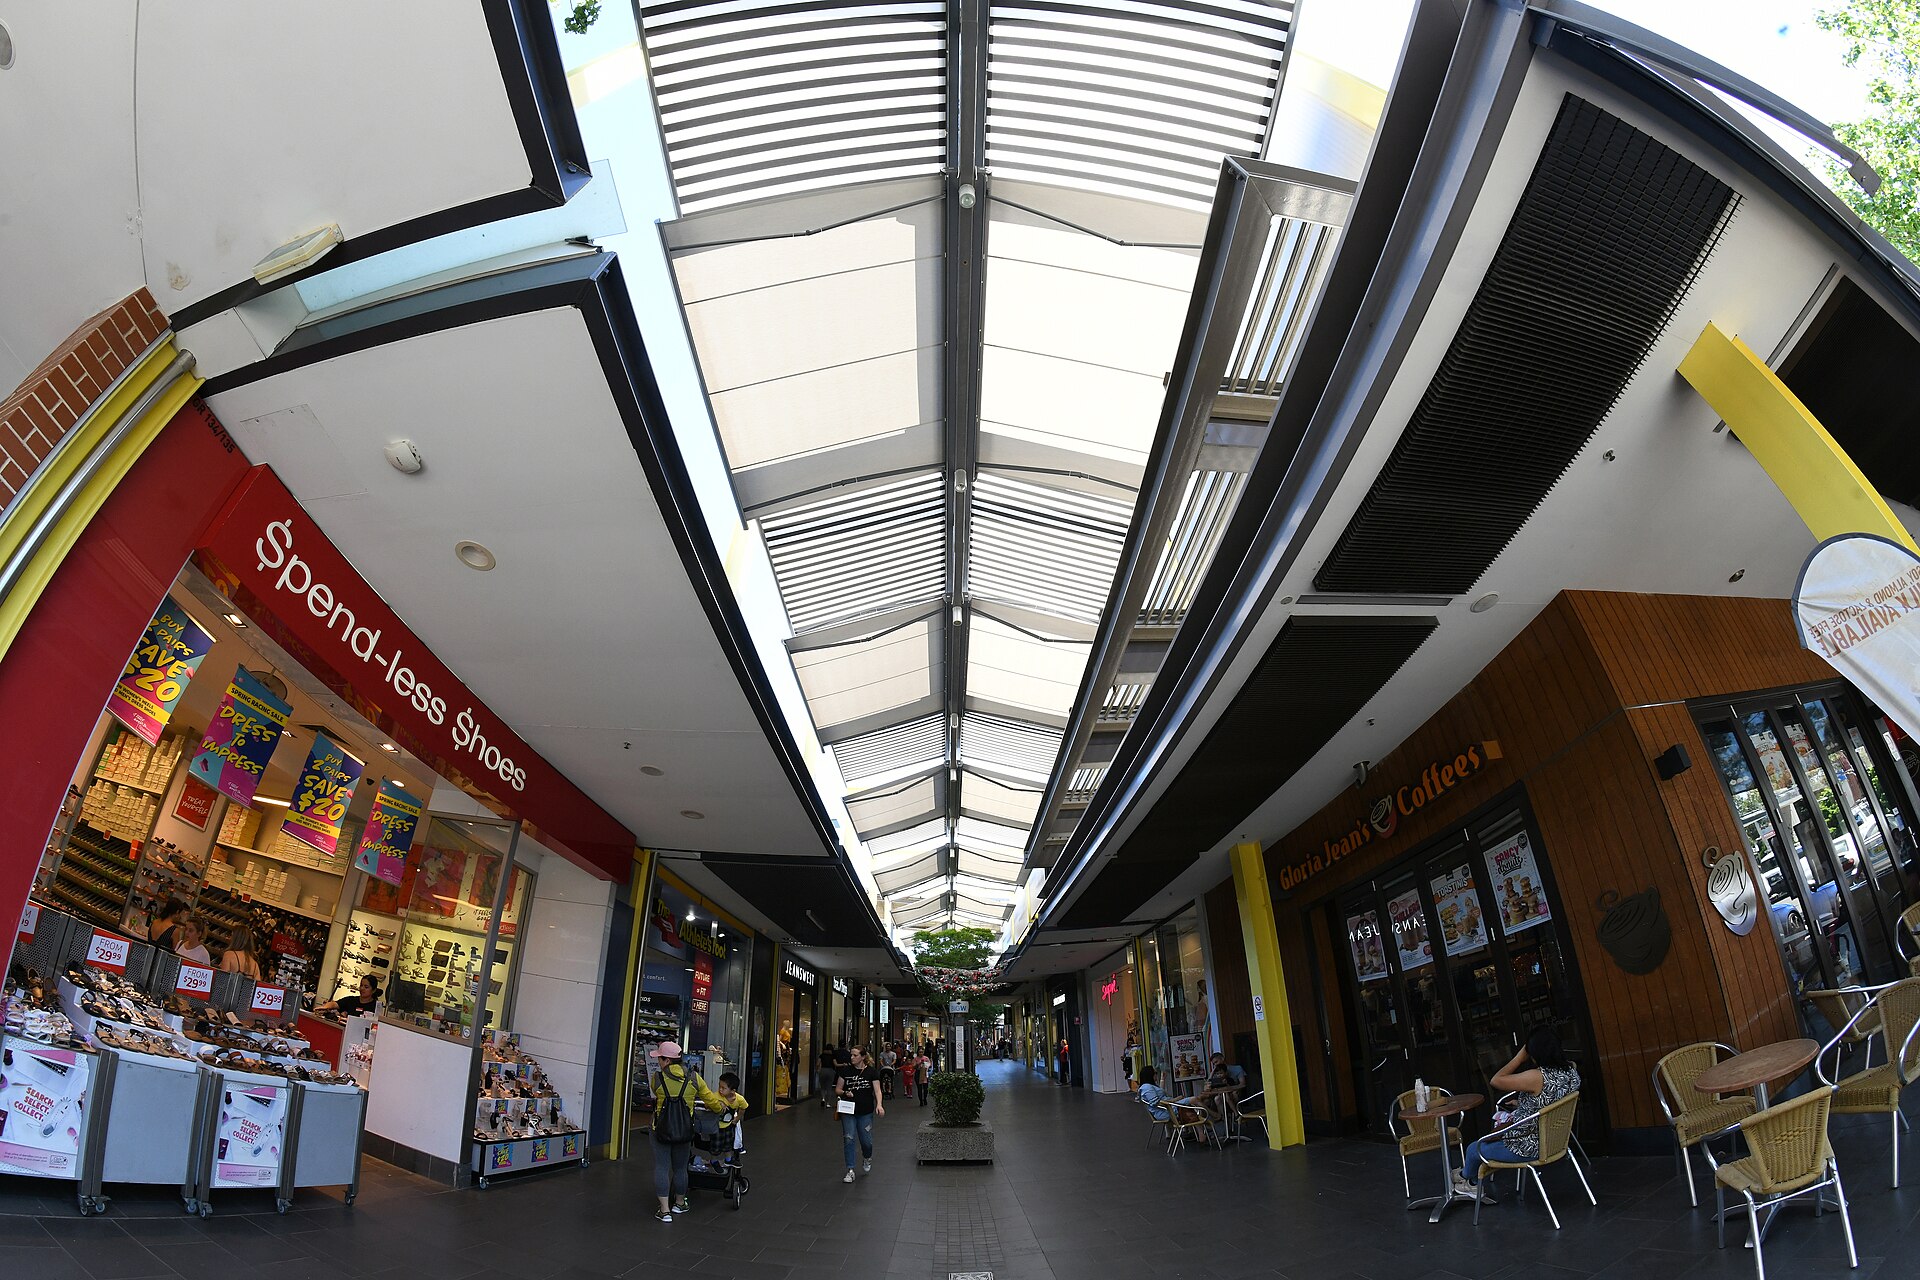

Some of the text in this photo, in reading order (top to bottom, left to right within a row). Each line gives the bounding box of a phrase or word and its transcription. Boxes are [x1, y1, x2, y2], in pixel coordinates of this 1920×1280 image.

[204, 413, 235, 453] 134/135
[160, 614, 185, 633] BUY
[156, 628, 194, 656] PAIRS
[231, 687, 284, 723] SPRING RACING SALE
[220, 705, 277, 742] DRESS
[202, 739, 264, 775] IMPRESS
[325, 753, 342, 766] BUY
[312, 760, 351, 782] 2 PAIRS
[1397, 746, 1480, 816] Coffees
[304, 775, 348, 802] SAVE
[181, 800, 209, 815] YOURSELF
[188, 795, 206, 806] TREAT
[298, 790, 345, 821] $20
[372, 811, 414, 832] DRESS
[362, 840, 407, 859] IMPRESS
[1280, 820, 1370, 890] Gloria Jean's
[1494, 845, 1519, 864] FANCY
[100, 938, 123, 952] FROM
[187, 968, 208, 979] FROM
[785, 960, 814, 986] JEANSWEST
[24, 1096, 50, 1115] SELECT.
[26, 1087, 54, 1108] SEARCH.
[14, 1101, 44, 1122] COLLECT.
[240, 1126, 258, 1138] SELECT.
[242, 1119, 261, 1133] SEARCH.
[233, 1130, 255, 1145] COLLECT.
